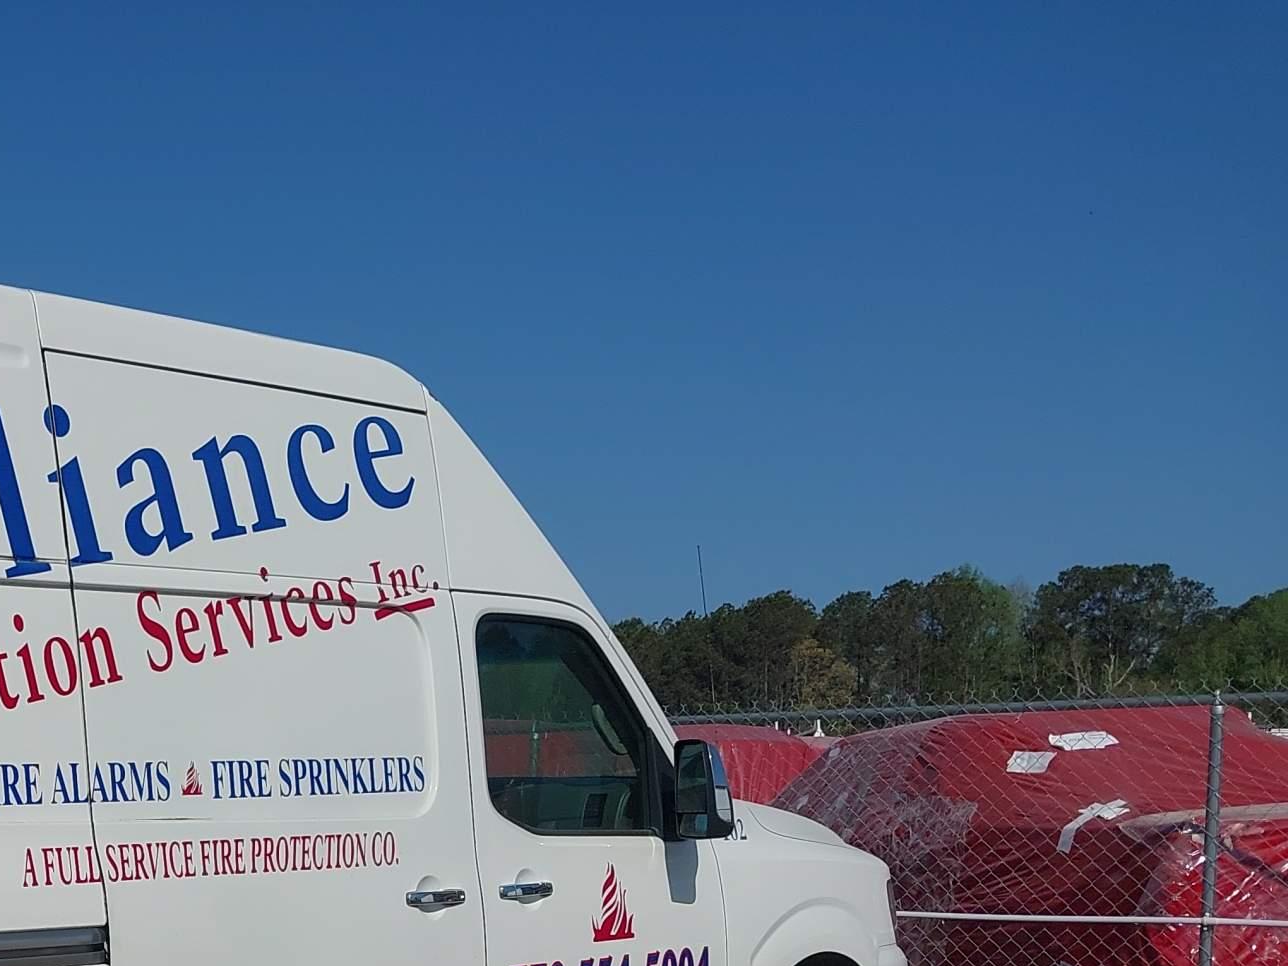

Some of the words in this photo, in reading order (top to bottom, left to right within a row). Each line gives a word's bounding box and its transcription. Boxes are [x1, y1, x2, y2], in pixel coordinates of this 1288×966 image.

[137, 566, 357, 673] Services
[369, 561, 440, 604] Inc.
[51, 761, 171, 805] ALARMS
[211, 759, 272, 800] FIRE
[279, 756, 425, 797] SPRINKLERS
[724, 818, 747, 841] 02
[23, 848, 38, 888] A
[44, 846, 102, 886] FULL
[107, 839, 196, 882] SERVICE
[201, 837, 245, 877] FIRE
[251, 832, 368, 874] PROTECTION
[372, 831, 400, 867] CO.
